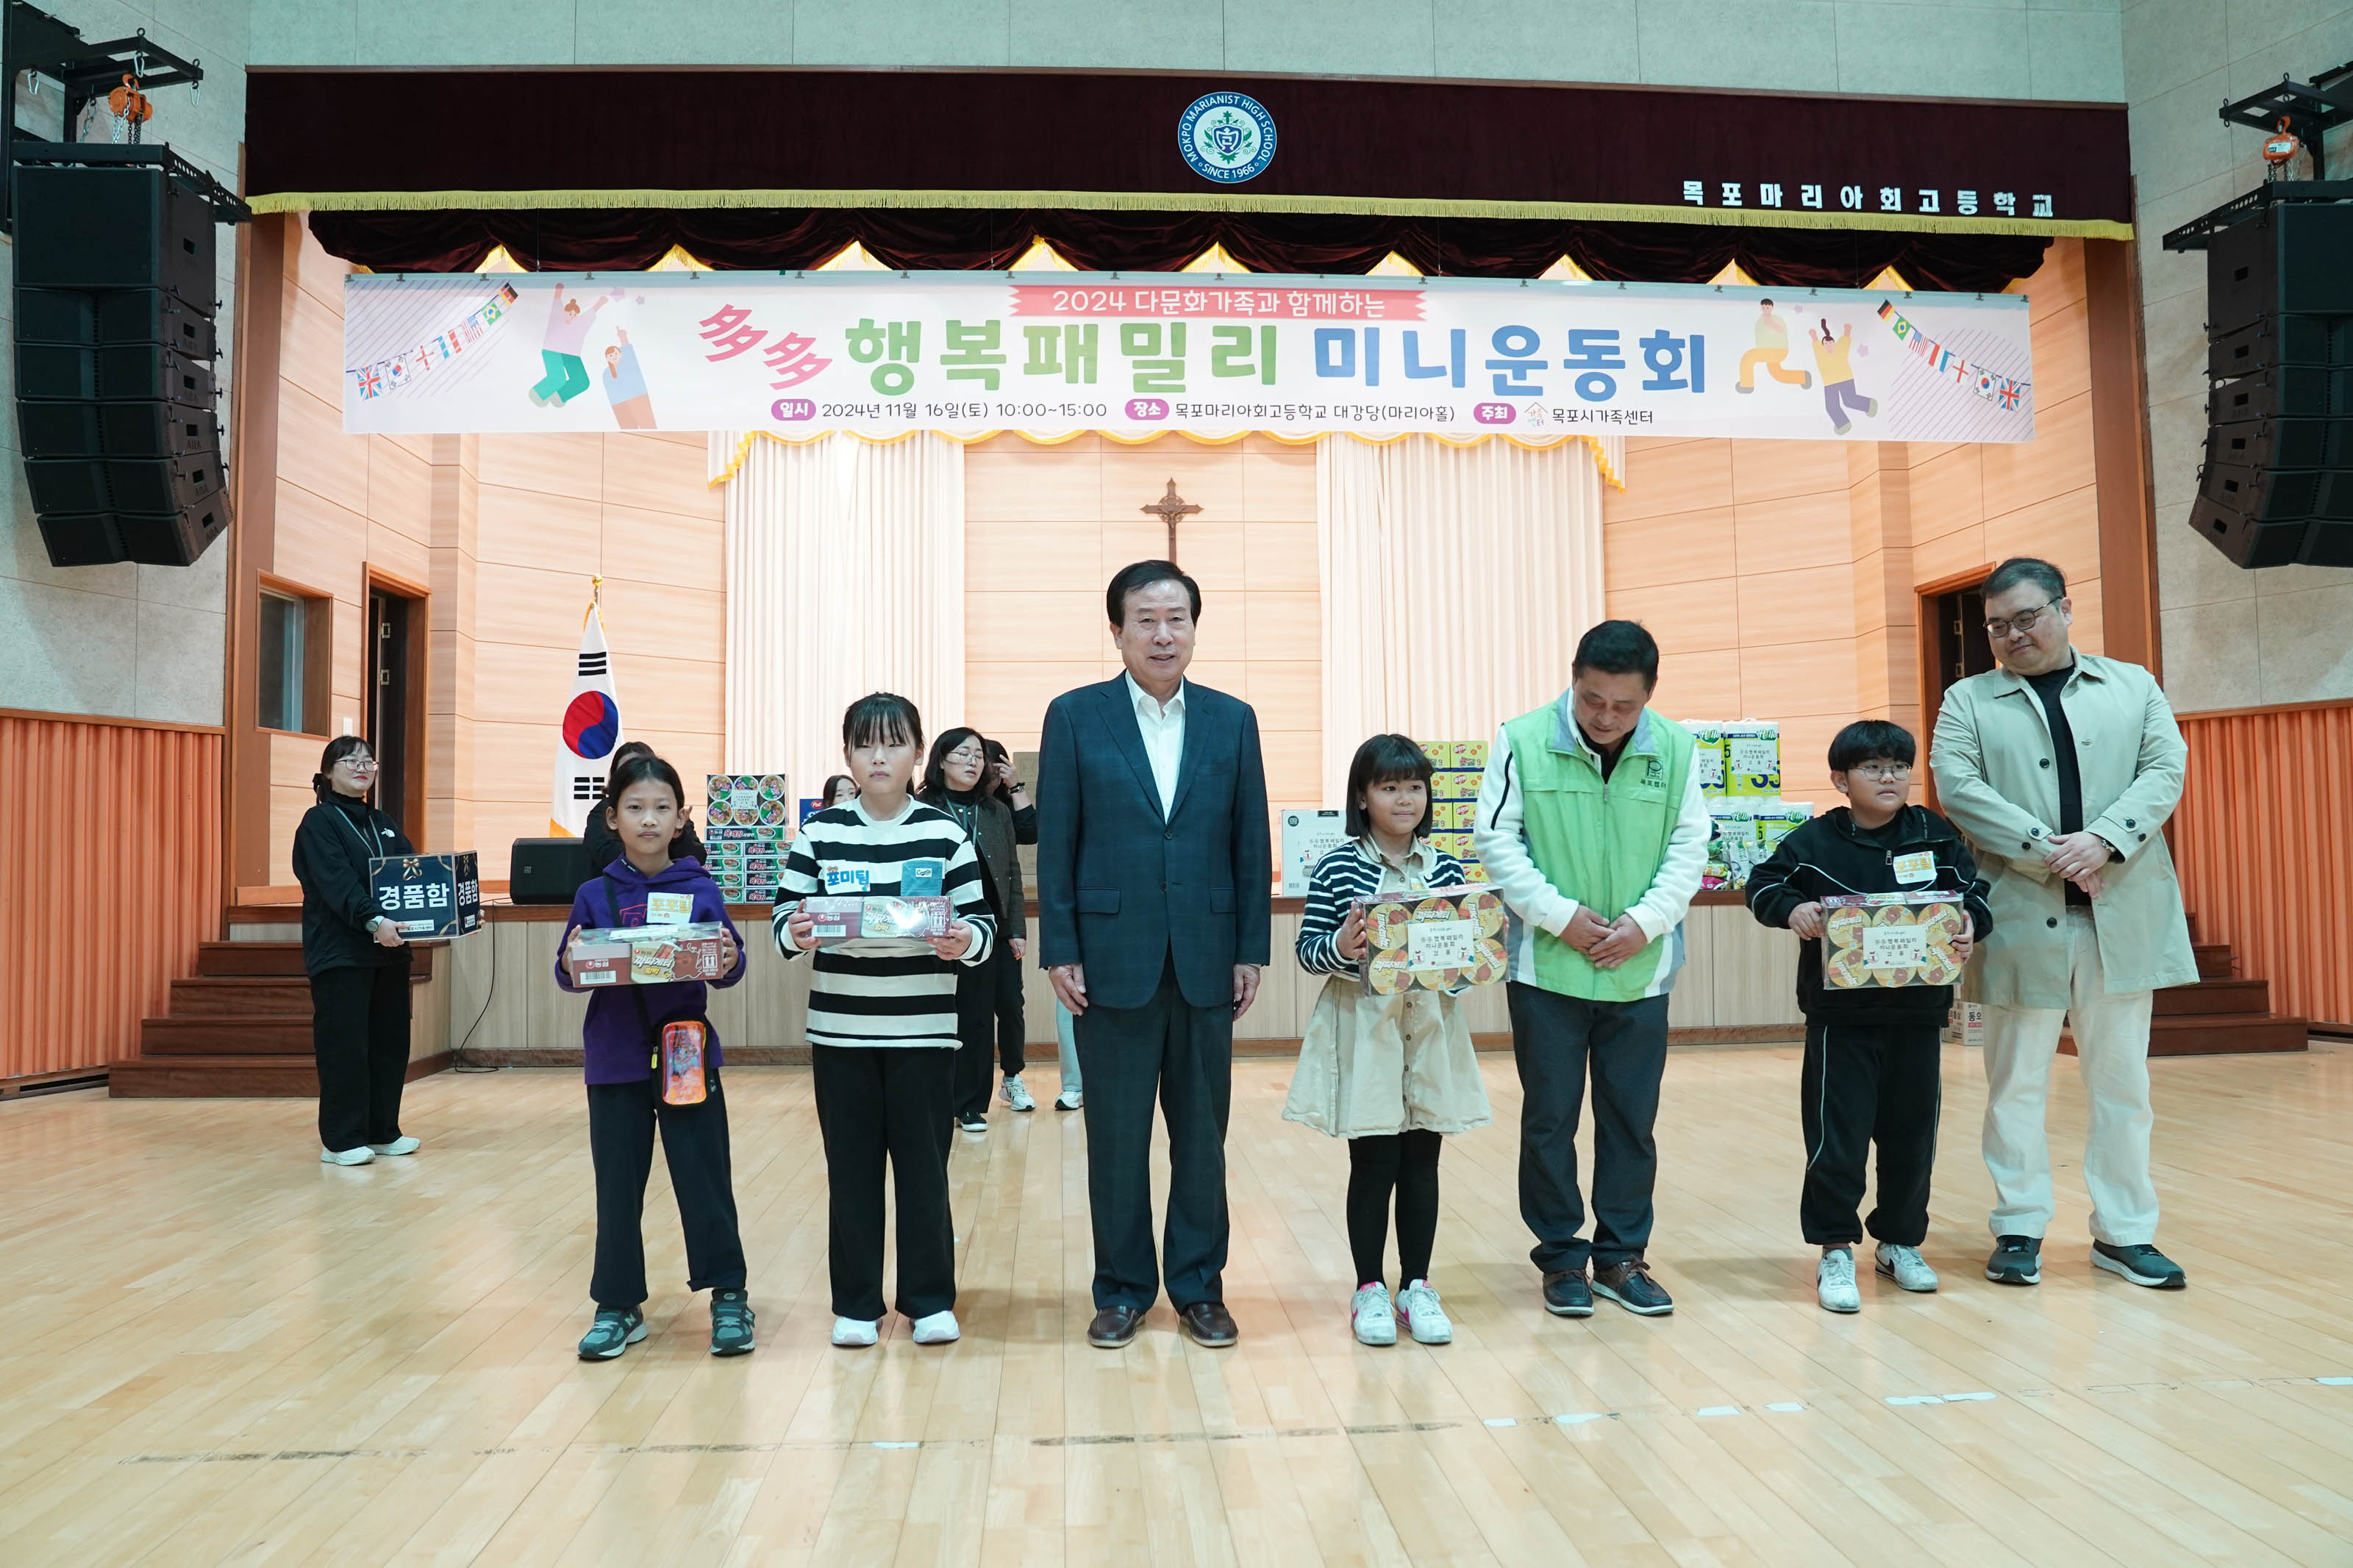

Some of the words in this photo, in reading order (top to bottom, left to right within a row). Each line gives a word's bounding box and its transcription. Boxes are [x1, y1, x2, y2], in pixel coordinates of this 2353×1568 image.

[1186, 95, 1240, 122] MARIANIST
[1241, 99, 1265, 121] HIGH
[1182, 123, 1199, 162] MOKPO
[1257, 120, 1274, 162] SCHOOL
[1202, 162, 1229, 179] SINCE
[1232, 162, 1255, 179] 1966
[1052, 290, 1126, 312] 2024
[1135, 290, 1280, 315] 다문화가족과
[1287, 290, 1385, 318] 함께하는
[845, 318, 1277, 396] 행복패밀리
[1314, 325, 1704, 402] 미니운동회
[779, 401, 808, 418] 일시
[822, 403, 880, 418] 2024년
[885, 402, 917, 419] 11월
[924, 401, 988, 419] 16일(토)
[996, 403, 1107, 417] 10:00~15:00
[1133, 401, 1161, 418] 장소
[1176, 403, 1327, 420] 목포마리아회고등학교
[1334, 404, 1454, 422] 대강당(마리아홀)
[1482, 405, 1507, 421] 주최
[1553, 408, 1653, 426] 목포시가족센터
[457, 878, 478, 906] 경품함
[826, 870, 869, 887] 포미팀
[379, 882, 450, 911] 경품함
[633, 956, 672, 969] 짜파게티
